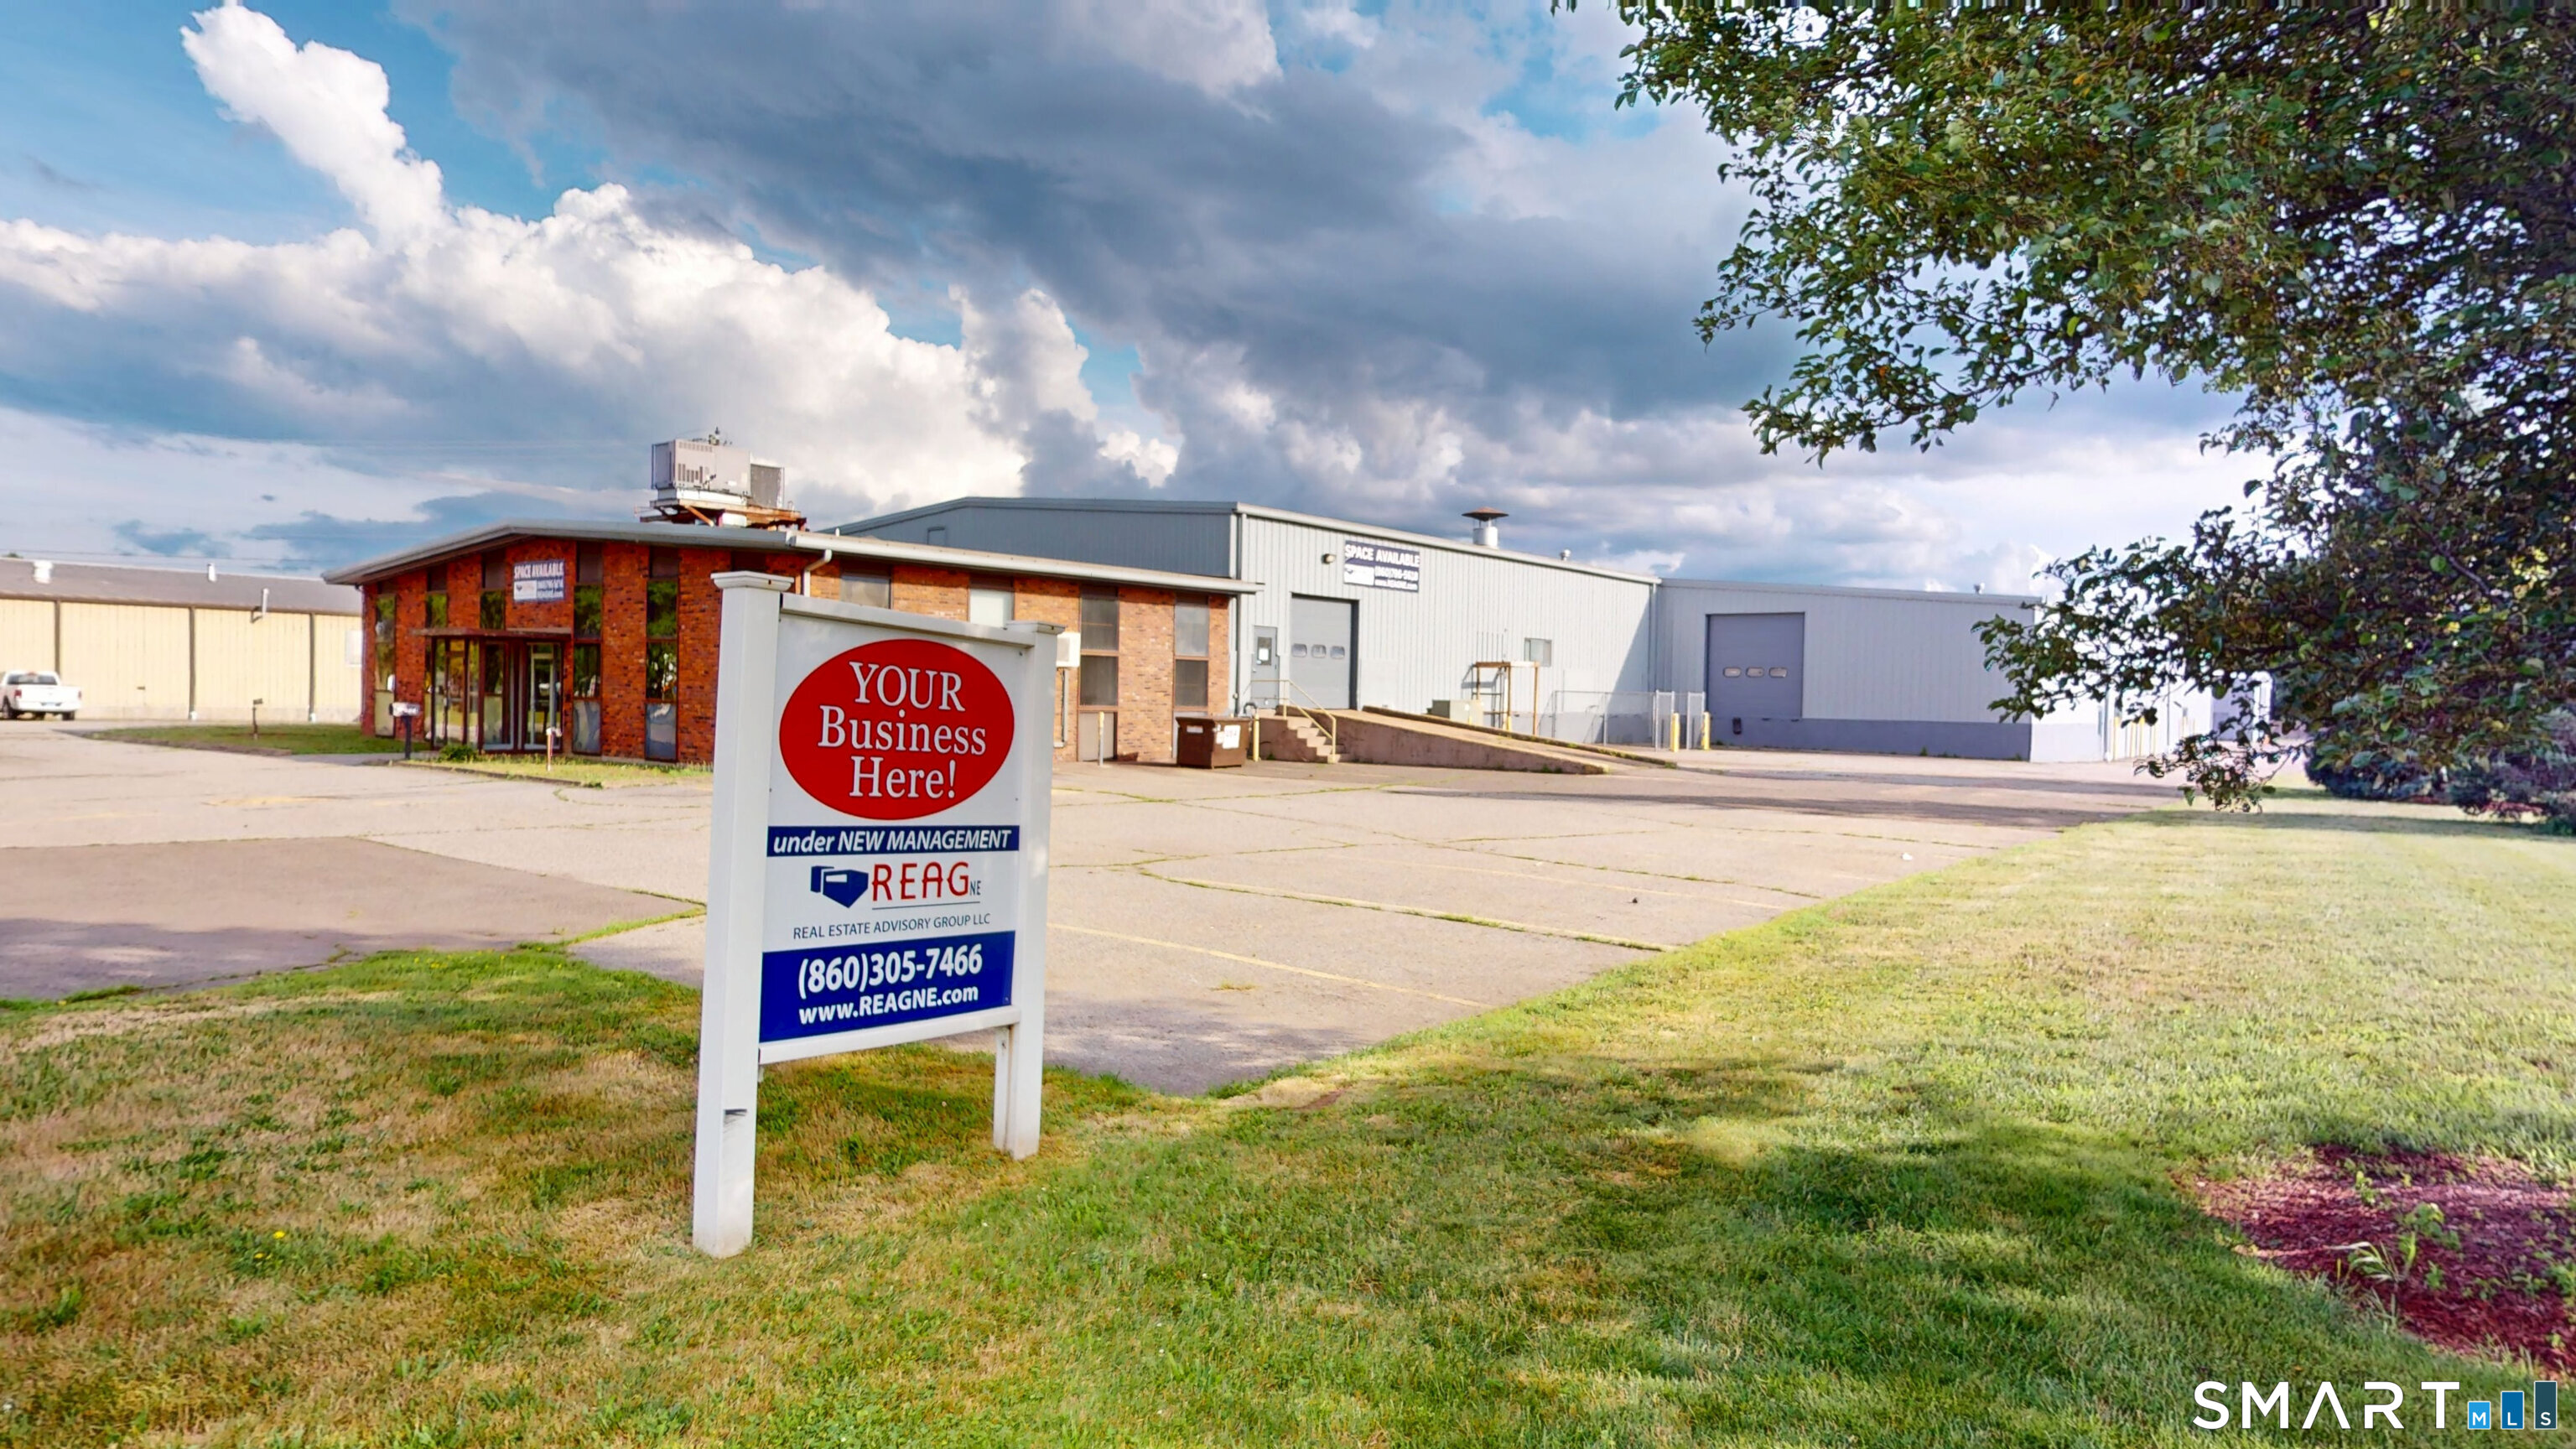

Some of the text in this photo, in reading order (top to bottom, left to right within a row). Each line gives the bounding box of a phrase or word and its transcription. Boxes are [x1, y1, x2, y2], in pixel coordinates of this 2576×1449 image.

[514, 562, 564, 579] SPACE AVAILABLE
[1345, 544, 1420, 568] SPACE AVAILABLE
[849, 662, 965, 711] YOUR
[818, 705, 986, 755] Business
[849, 756, 957, 799] Here!
[773, 829, 1012, 854] under NEW MANAGEMENT
[793, 913, 991, 940] REAL ESTATE ADVISORY GROUP LLC
[798, 943, 983, 1000] (860)305-7466
[798, 986, 979, 1025] www.REAGNE.com
